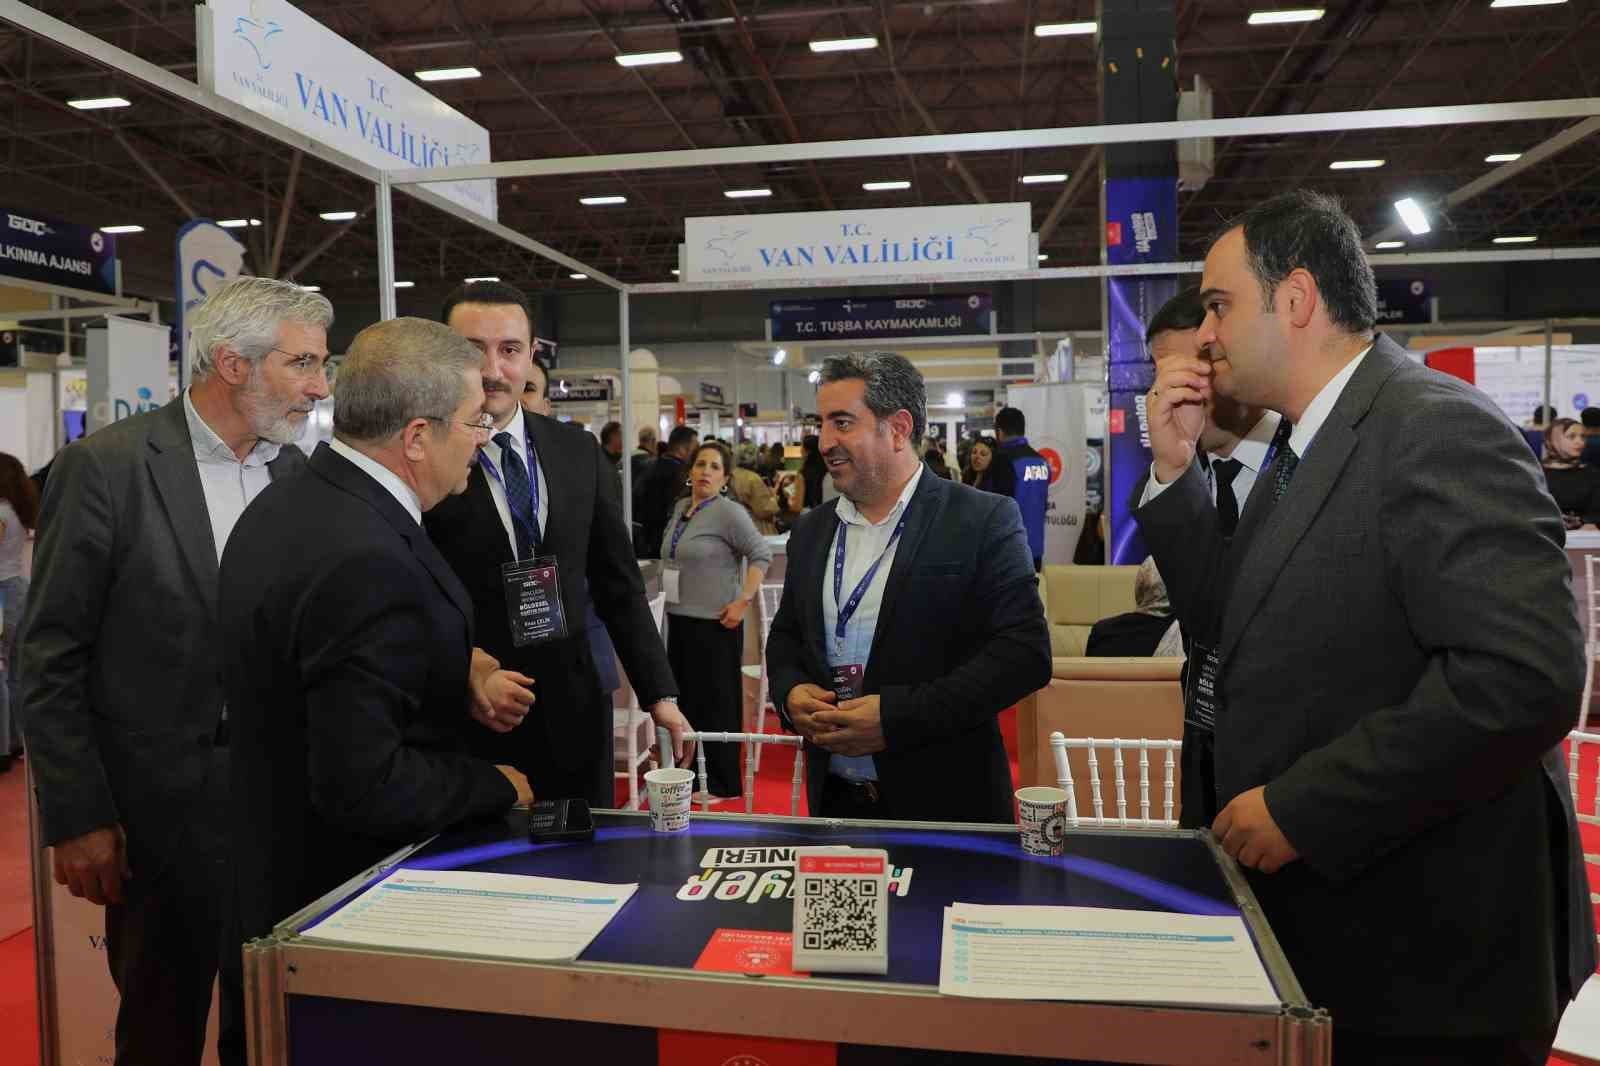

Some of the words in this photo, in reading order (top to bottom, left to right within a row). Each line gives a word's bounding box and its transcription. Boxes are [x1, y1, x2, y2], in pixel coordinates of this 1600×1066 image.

[367, 77, 394, 109] T.C.
[294, 71, 349, 130] VAN
[356, 103, 450, 169] VALİLİĞİ
[840, 223, 872, 237] T.C.
[49, 253, 92, 276] AJANSI
[759, 246, 816, 268] VAN
[824, 235, 956, 265] VALİLİĞİ
[796, 321, 817, 333] T.C.
[821, 319, 862, 333] TUŞBA
[865, 316, 961, 330] KAYMAKAMLIĞI
